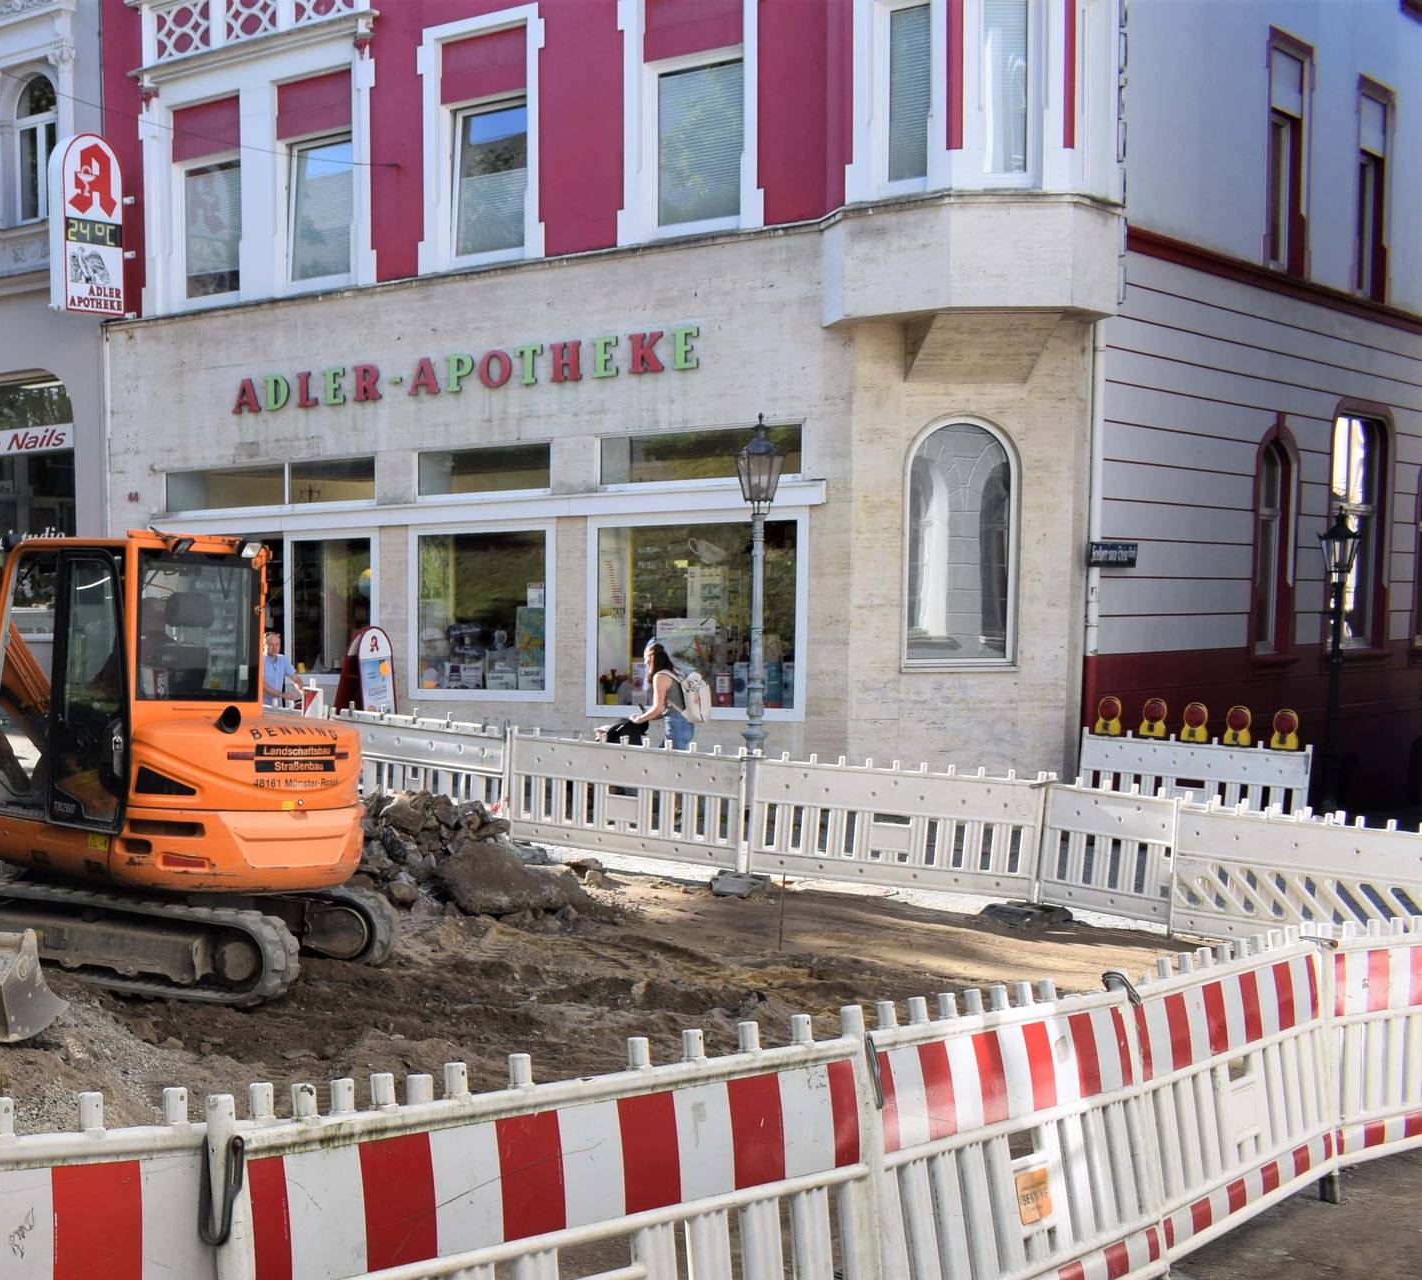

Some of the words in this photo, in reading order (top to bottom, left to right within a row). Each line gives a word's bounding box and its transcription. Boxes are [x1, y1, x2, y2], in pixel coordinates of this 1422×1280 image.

[88, 285, 121, 299] ADLER
[68, 295, 122, 311] APOTHEKE
[231, 325, 701, 415] ADLER-APOTHEKE
[7, 428, 67, 451] Nails
[250, 726, 338, 741] BENNING
[263, 745, 331, 756] Landschaftsbau
[274, 760, 324, 772] Straßenbau
[254, 778, 282, 788] 48161
